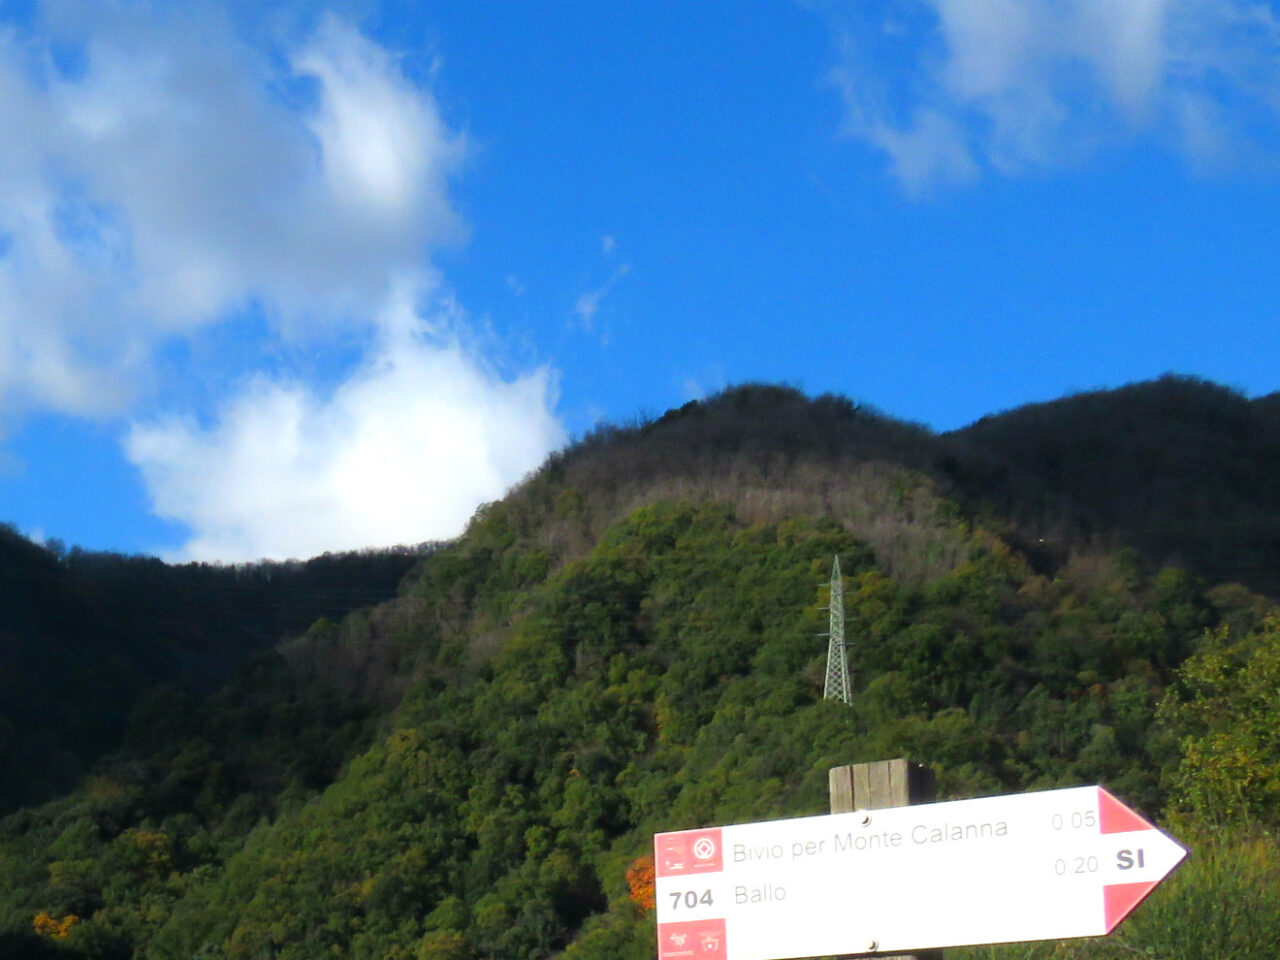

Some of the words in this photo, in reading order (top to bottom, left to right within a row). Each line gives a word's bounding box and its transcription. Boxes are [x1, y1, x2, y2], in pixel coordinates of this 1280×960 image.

[732, 842, 785, 864] Bivio
[791, 838, 826, 862] per
[833, 831, 903, 853] Monte
[910, 820, 1009, 845] Calanna
[1115, 847, 1146, 871] SI
[734, 883, 787, 905] Ballo
[1054, 855, 1099, 877] 0.20
[668, 888, 715, 911] 704
